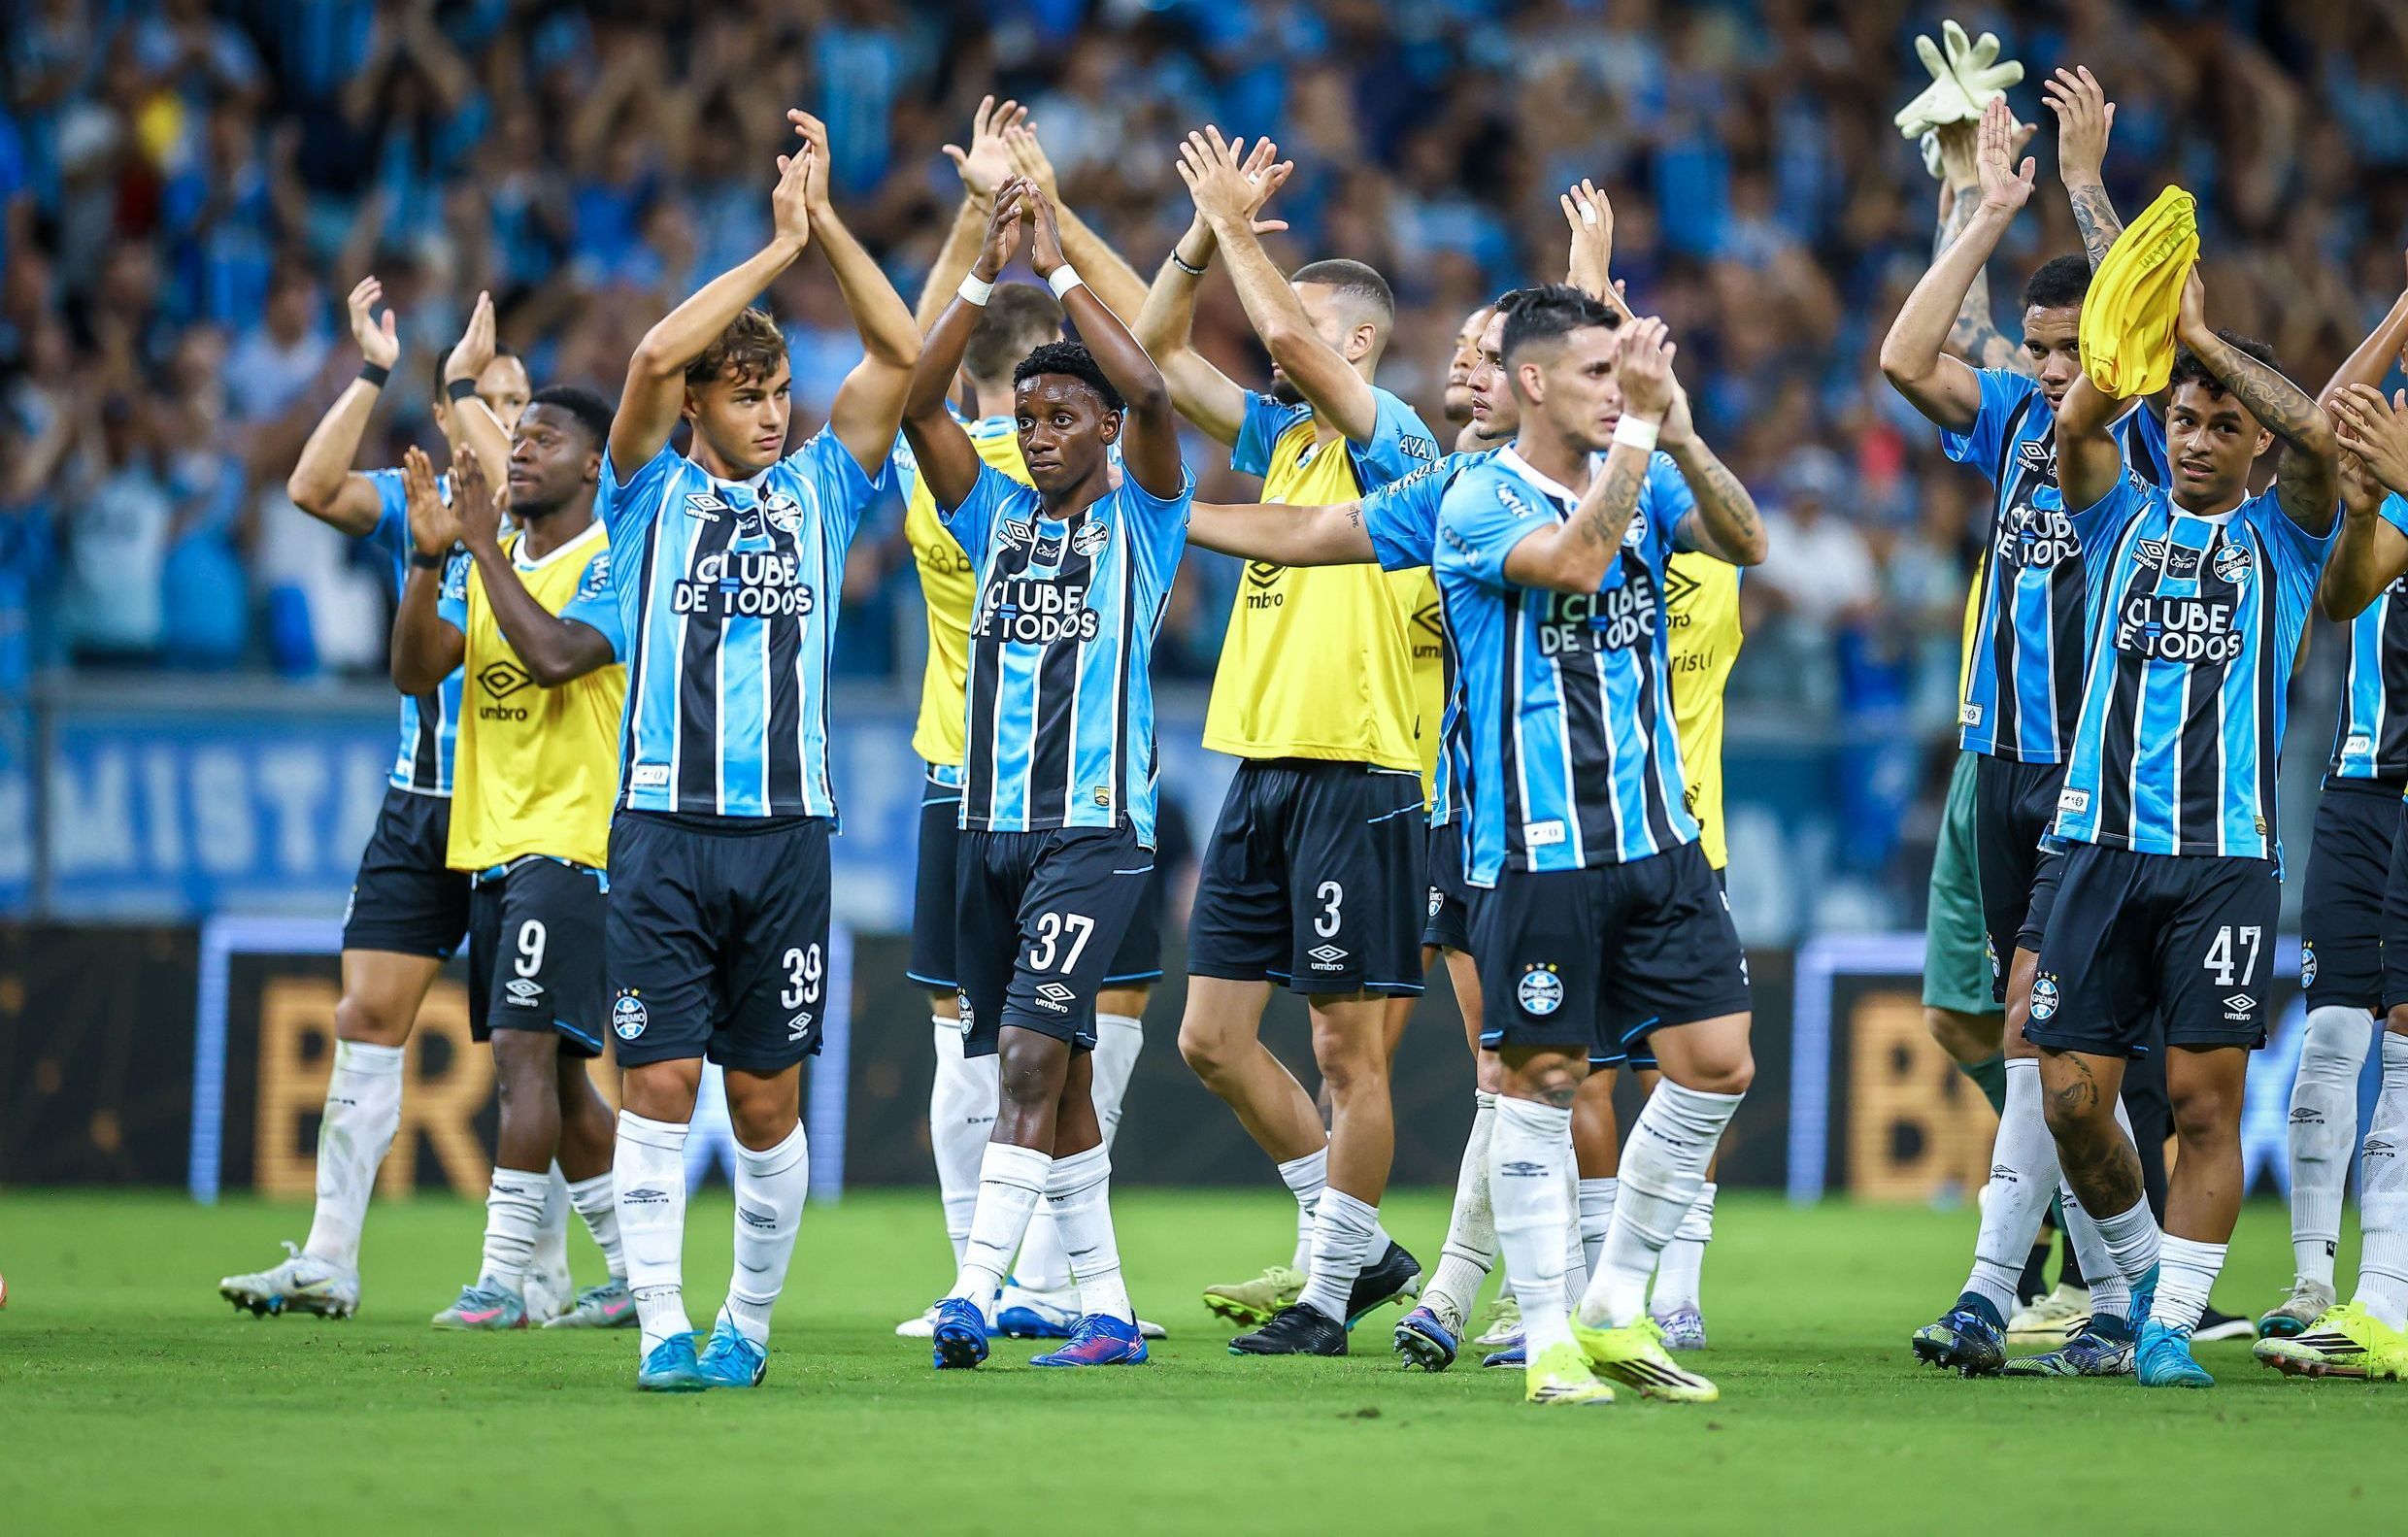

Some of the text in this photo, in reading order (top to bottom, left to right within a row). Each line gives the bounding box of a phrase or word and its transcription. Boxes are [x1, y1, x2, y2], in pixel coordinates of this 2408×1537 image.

[686, 507, 720, 523] umbro
[998, 530, 1022, 551] umbro
[1036, 547, 1059, 559] Coral
[696, 553, 796, 587] CLUBE
[2132, 551, 2158, 571] umbro
[2169, 557, 2193, 569] Coral
[674, 583, 813, 616] DE TODOS
[987, 581, 1084, 616] CLUBE
[999, 611, 1097, 642] TODOS
[1540, 623, 1581, 655] DE
[1588, 607, 1656, 651] TODO
[2126, 597, 2230, 634] CLUBE
[2117, 622, 2241, 661] E TODOS
[480, 704, 528, 721] umbro
[1314, 881, 1344, 938] 3
[514, 919, 547, 978] 9
[1029, 912, 1095, 975] 37
[2203, 925, 2261, 986] 47
[781, 942, 822, 1010] 39
[1311, 961, 1344, 972] umbro
[1035, 997, 1068, 1014] umbro
[2224, 1011, 2252, 1020] umbro
